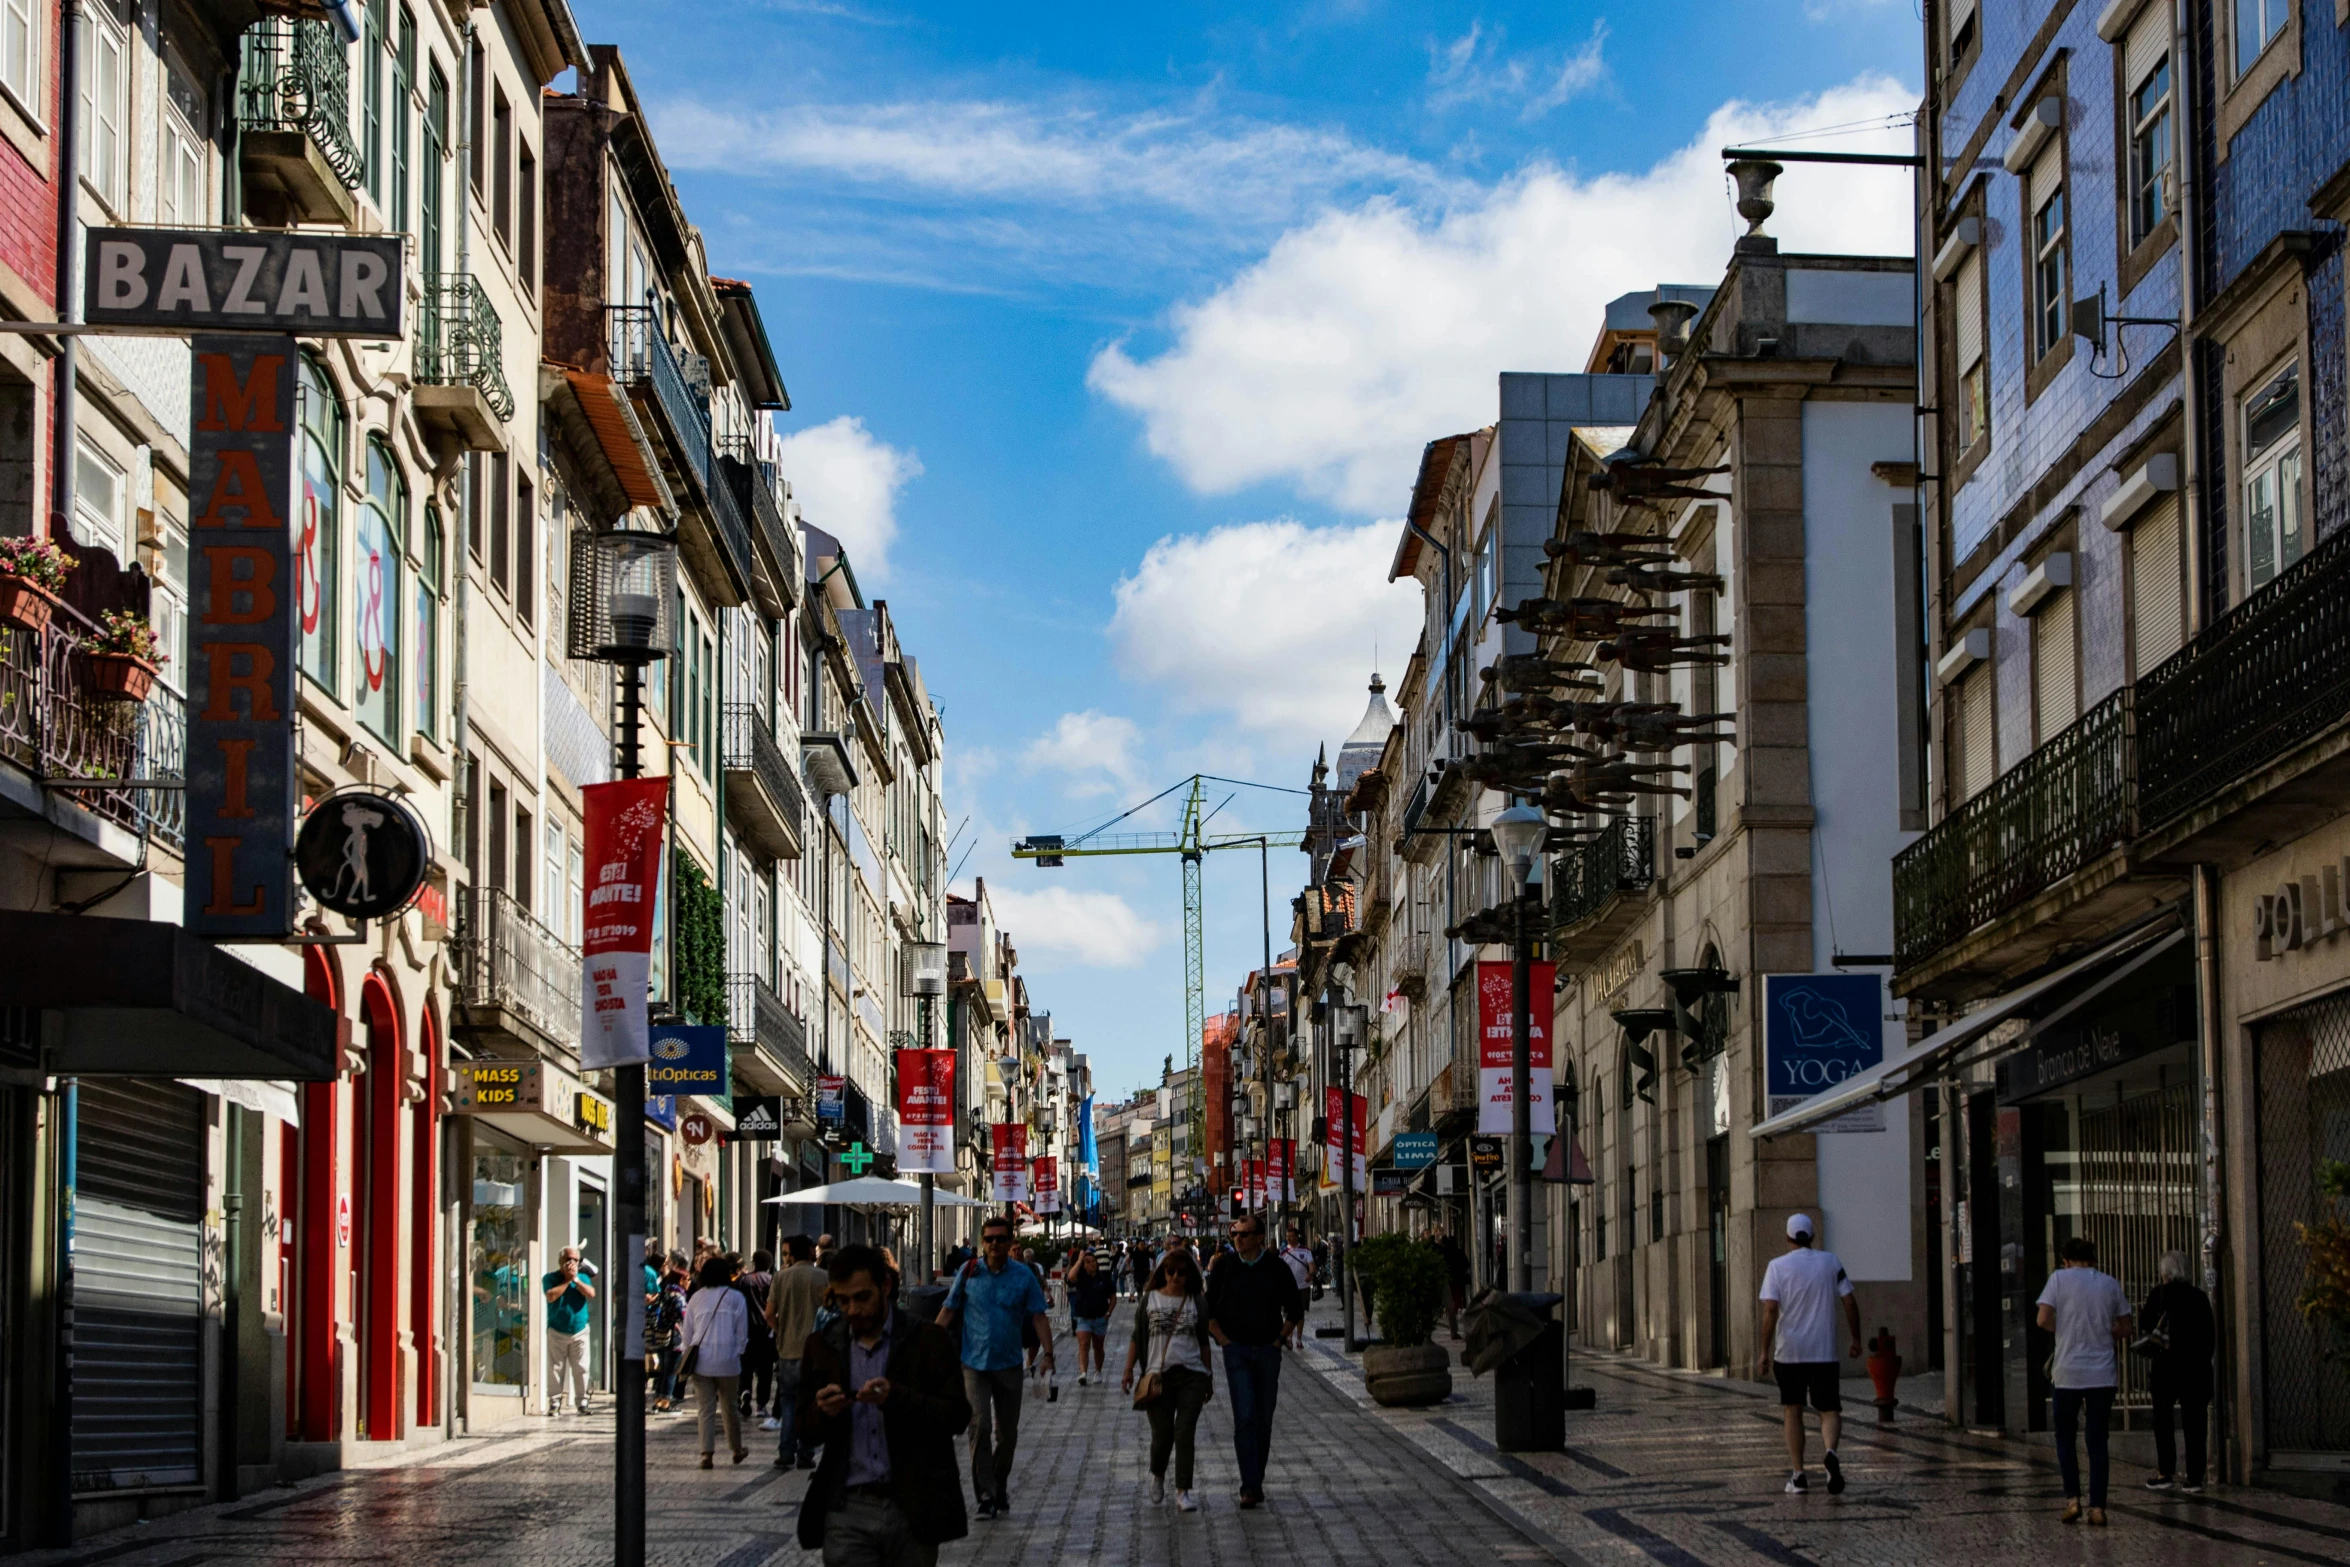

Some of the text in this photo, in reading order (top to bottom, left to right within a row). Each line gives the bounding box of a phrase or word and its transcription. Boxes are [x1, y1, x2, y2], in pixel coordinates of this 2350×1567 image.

[97, 240, 389, 320] BAZAR
[196, 353, 286, 917] MABRIL
[2077, 1029, 2091, 1070] de
[2091, 1024, 2121, 1065] Neve
[473, 1068, 521, 1083] MASS
[648, 1067, 717, 1083] ltiOpticas
[1782, 1057, 1866, 1085] YOGA
[476, 1088, 516, 1104] KIDS
[906, 1095, 947, 1105] AVANTE!
[739, 1120, 778, 1131] adidas
[1396, 1140, 1436, 1148] ÓPTICA
[1396, 1151, 1436, 1160] LIMA
